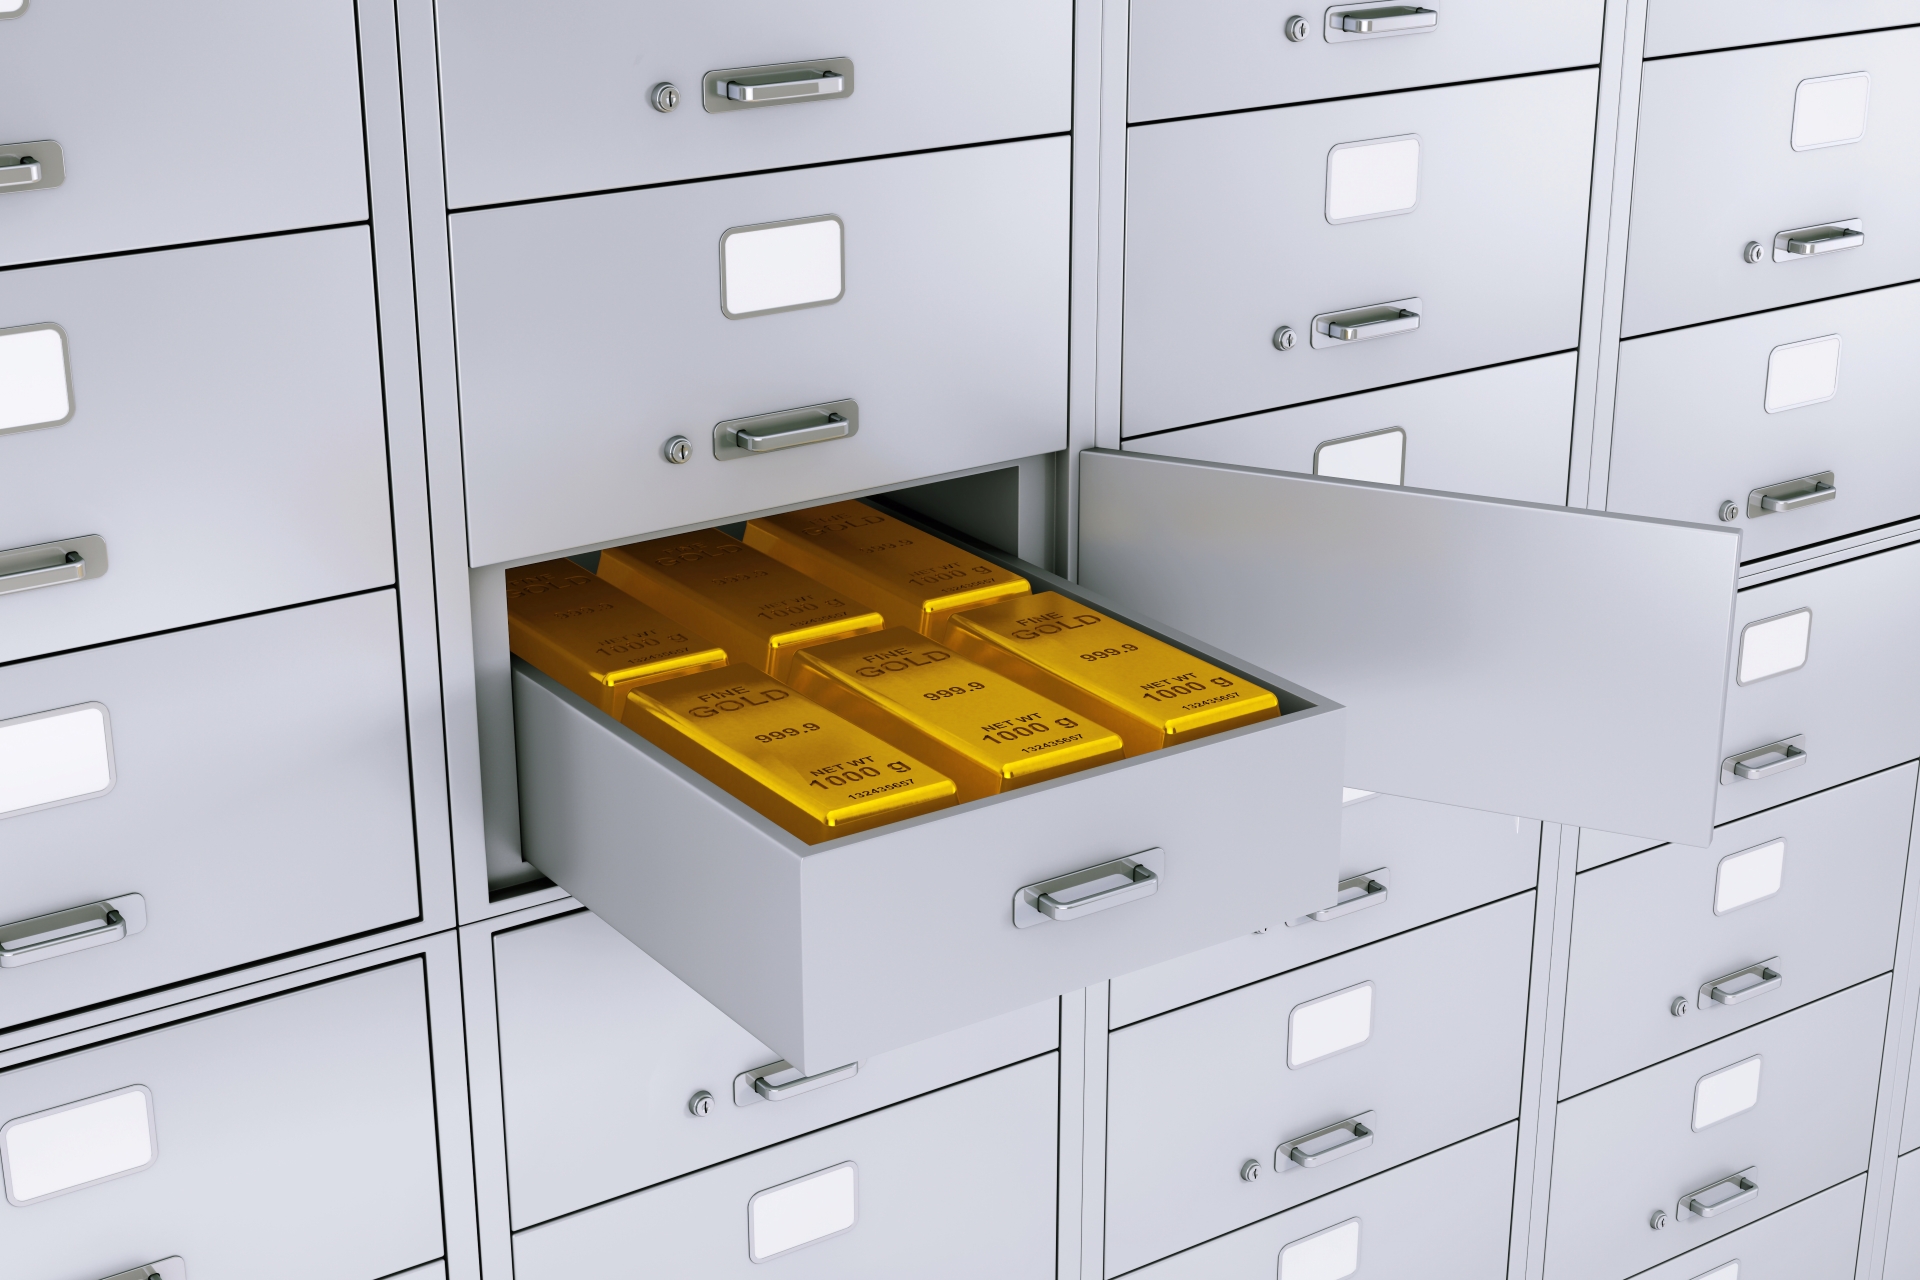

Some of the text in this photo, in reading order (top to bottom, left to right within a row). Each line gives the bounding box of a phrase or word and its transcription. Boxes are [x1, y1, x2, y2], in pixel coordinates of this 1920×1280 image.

[802, 515, 885, 536] GOLD
[655, 544, 743, 566] GOLD
[908, 565, 992, 587] 1000 g
[941, 562, 962, 571] WT
[757, 598, 845, 620] 1000 g
[794, 593, 814, 604] WT
[1011, 614, 1102, 640] GOLD
[1015, 611, 1064, 627] FINE
[633, 628, 657, 639] WT
[596, 632, 689, 660] 1000 g
[863, 647, 913, 663] FINE
[1079, 643, 1139, 662] 999.9
[855, 650, 951, 678] GOLD
[923, 681, 985, 701] 999.9
[1140, 672, 1198, 691] NET WT
[1142, 676, 1234, 703] 1000 g
[688, 688, 790, 718] GOLD
[697, 685, 750, 703] FINE
[754, 722, 821, 743] 999.9
[980, 712, 1042, 732] NET WT
[982, 717, 1079, 745] 1000 g
[809, 755, 876, 777] NET WT
[809, 760, 912, 790] 1000 g
